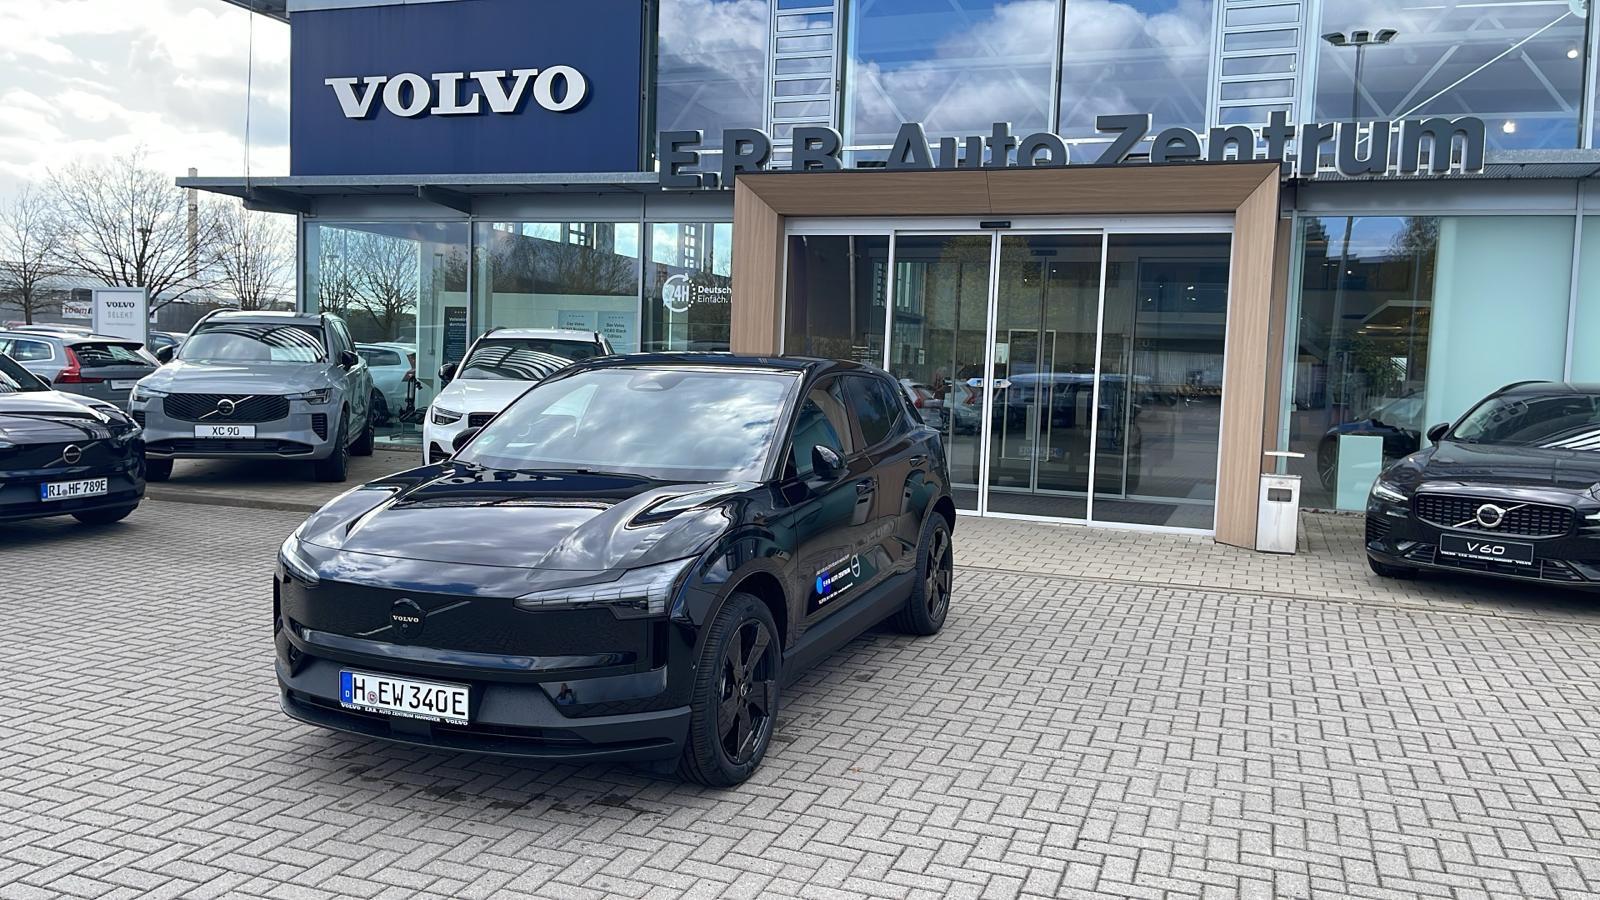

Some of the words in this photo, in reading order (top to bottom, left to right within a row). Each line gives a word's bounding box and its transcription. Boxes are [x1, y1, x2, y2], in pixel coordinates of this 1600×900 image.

[325, 65, 586, 118] VOLVO
[885, 122, 1070, 168] Auto
[1095, 110, 1487, 178] Zentrum
[665, 284, 690, 302] 24H
[697, 294, 729, 303] Einfach.
[105, 301, 135, 309] VOLVO
[212, 427, 225, 436] XC
[227, 427, 240, 436] 90
[48, 484, 61, 497] RI
[68, 482, 81, 495] HF
[83, 479, 106, 493] 789E
[1467, 541, 1505, 555] V60
[392, 615, 419, 623] VOLVO
[353, 677, 366, 701] H
[378, 681, 405, 707] EW
[340, 702, 361, 711] VOLVO
[391, 710, 414, 719] ZENTRUM
[445, 718, 468, 726] VOLVO
